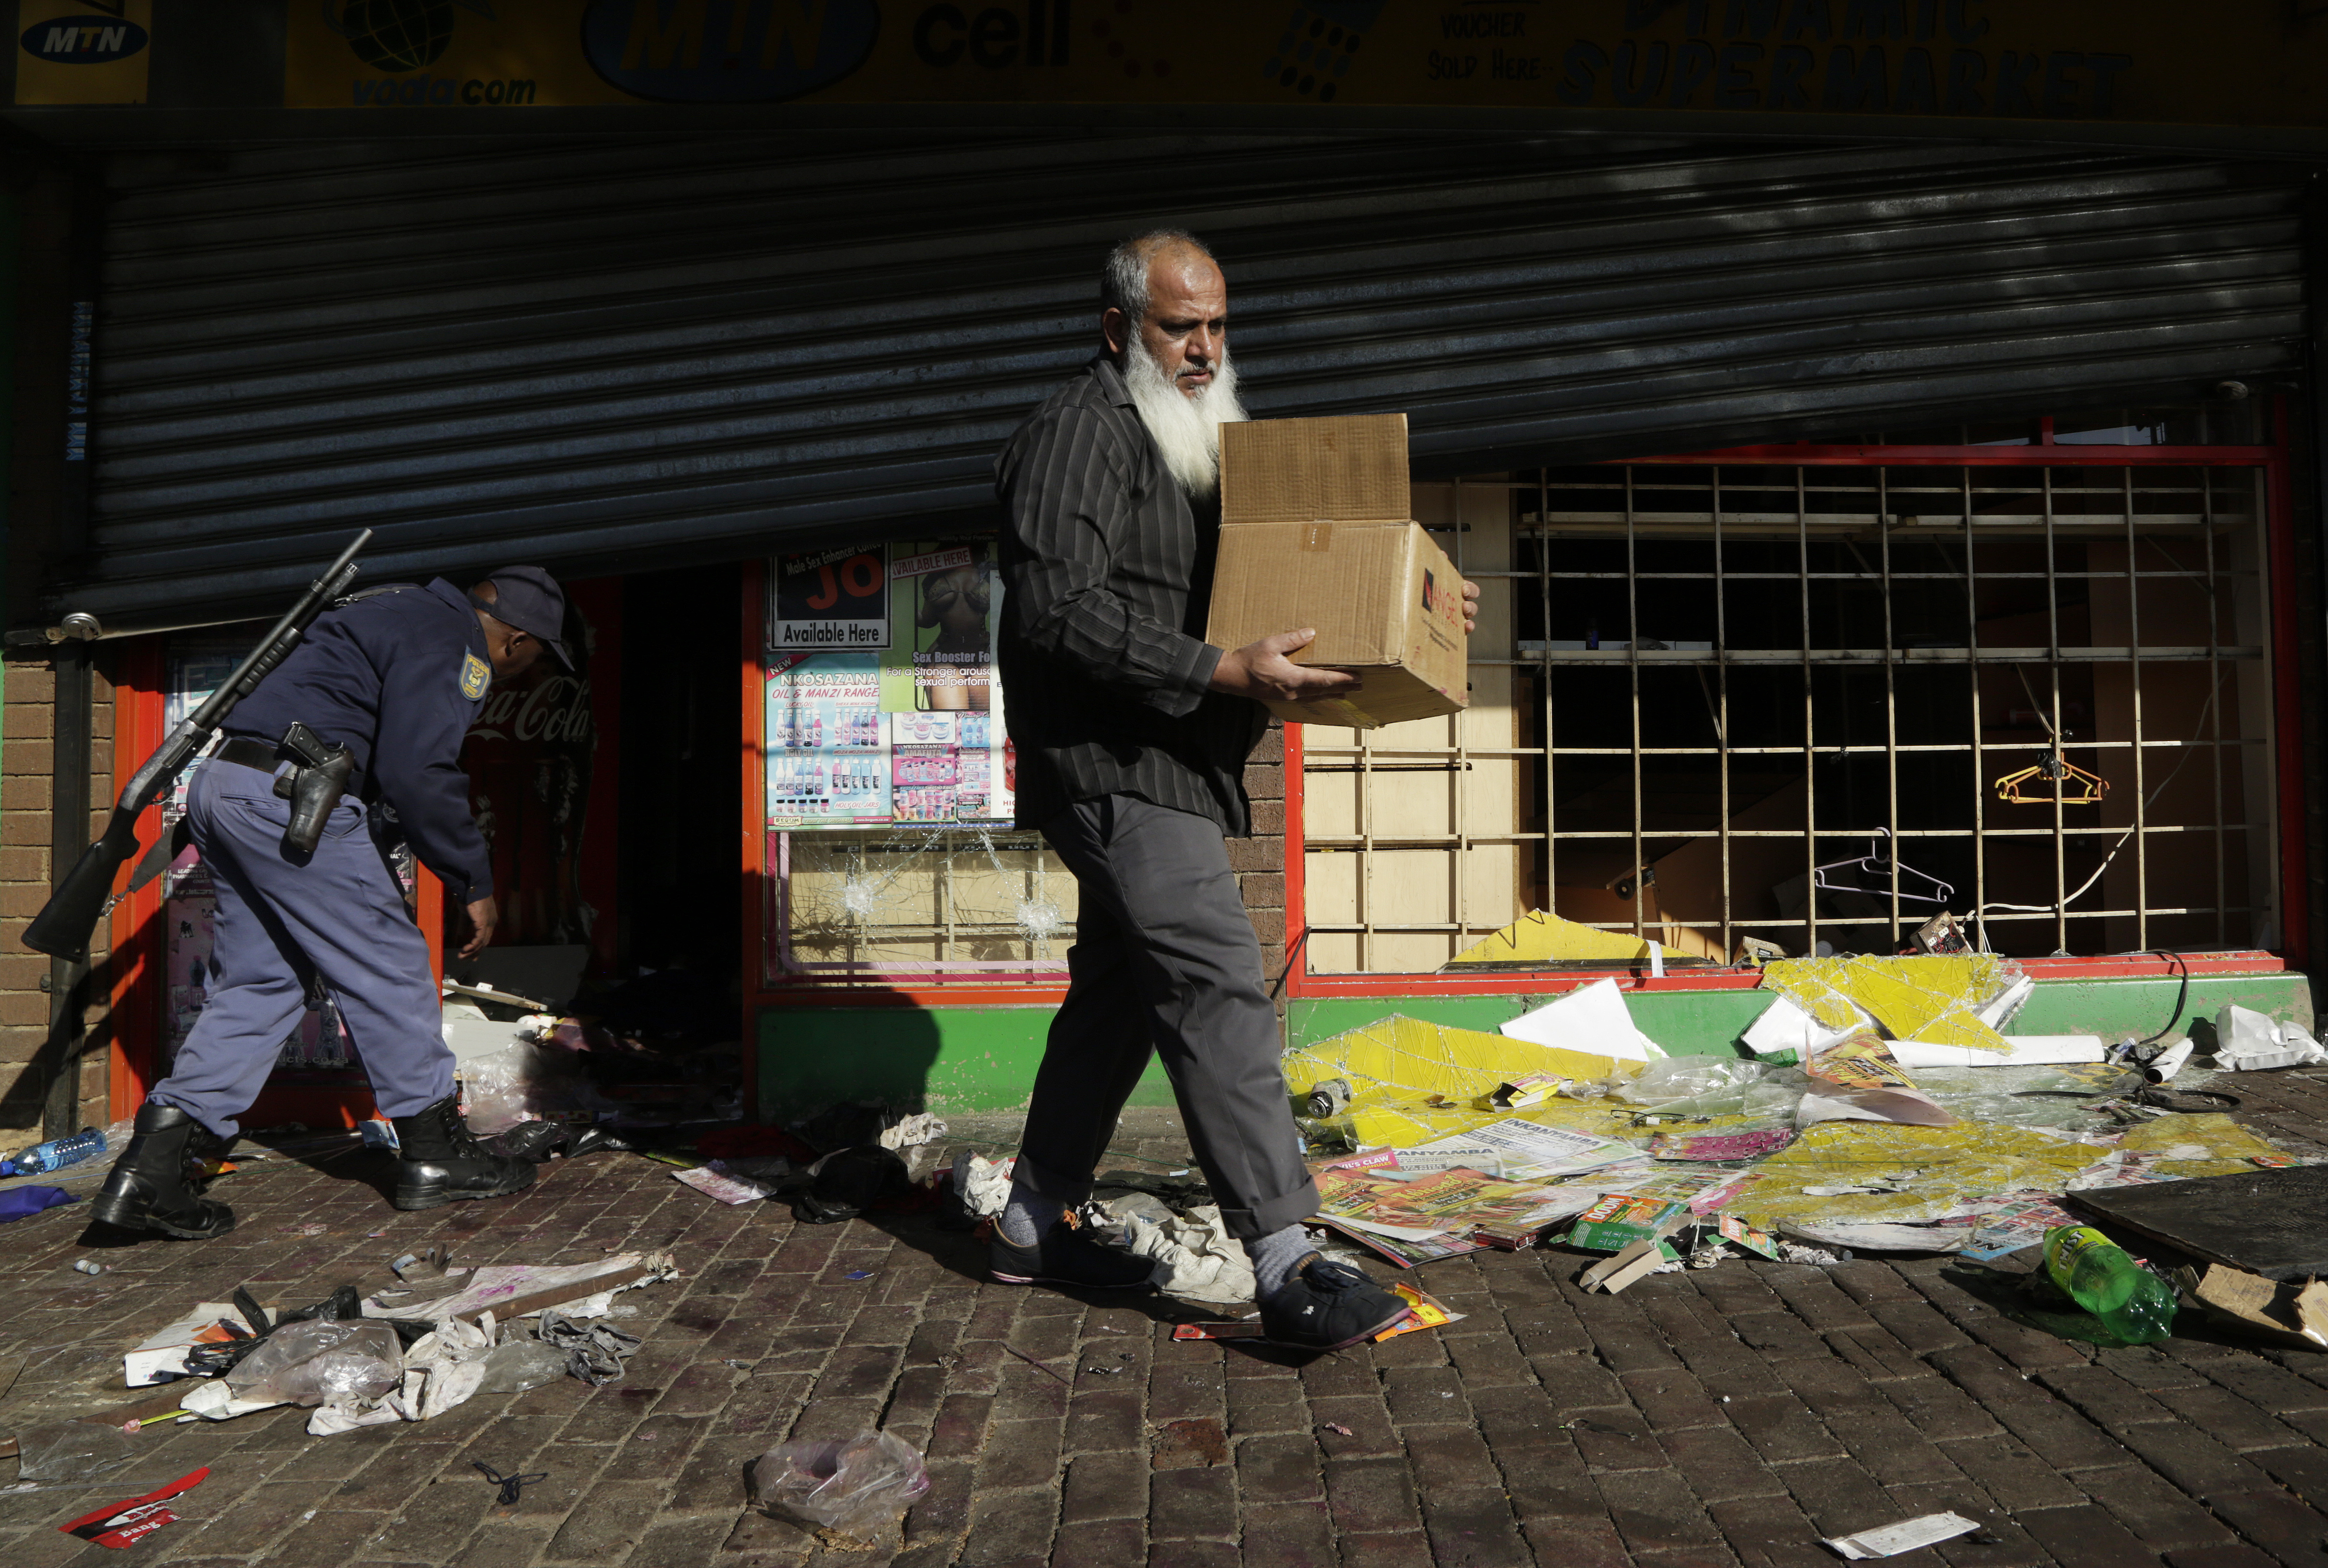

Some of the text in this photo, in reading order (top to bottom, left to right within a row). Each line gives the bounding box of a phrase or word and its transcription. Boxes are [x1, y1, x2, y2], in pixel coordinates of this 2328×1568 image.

[913, 0, 1069, 68] cell
[1441, 13, 1526, 39] VOUCHER
[43, 26, 127, 52] MTN
[1428, 49, 1478, 80] SOLD
[1554, 40, 2132, 118] SUPERMARKET
[353, 74, 536, 106] vodacom
[786, 558, 806, 576] Male
[806, 556, 822, 570] Sex
[821, 547, 856, 565] Enhancer
[943, 550, 969, 567] HERE
[807, 554, 884, 610] JO
[784, 622, 879, 642] Available Here
[769, 657, 792, 675] NEW
[913, 651, 931, 663] Sex
[934, 651, 975, 663] Booster
[780, 673, 879, 686] NKOSAZANA
[887, 667, 902, 676] For
[915, 666, 956, 677] Stronger
[916, 677, 947, 686] sexual
[772, 687, 879, 698] OIL & MANZI RANGE
[785, 749, 802, 757] HOLY
[1504, 1119, 1600, 1146] INKANYAMBA
[1362, 1155, 1389, 1166] CLAW
[1587, 1197, 1625, 1220] DOOM
[1728, 1219, 1740, 1237] DOOM
[118, 1521, 161, 1537] Bang
